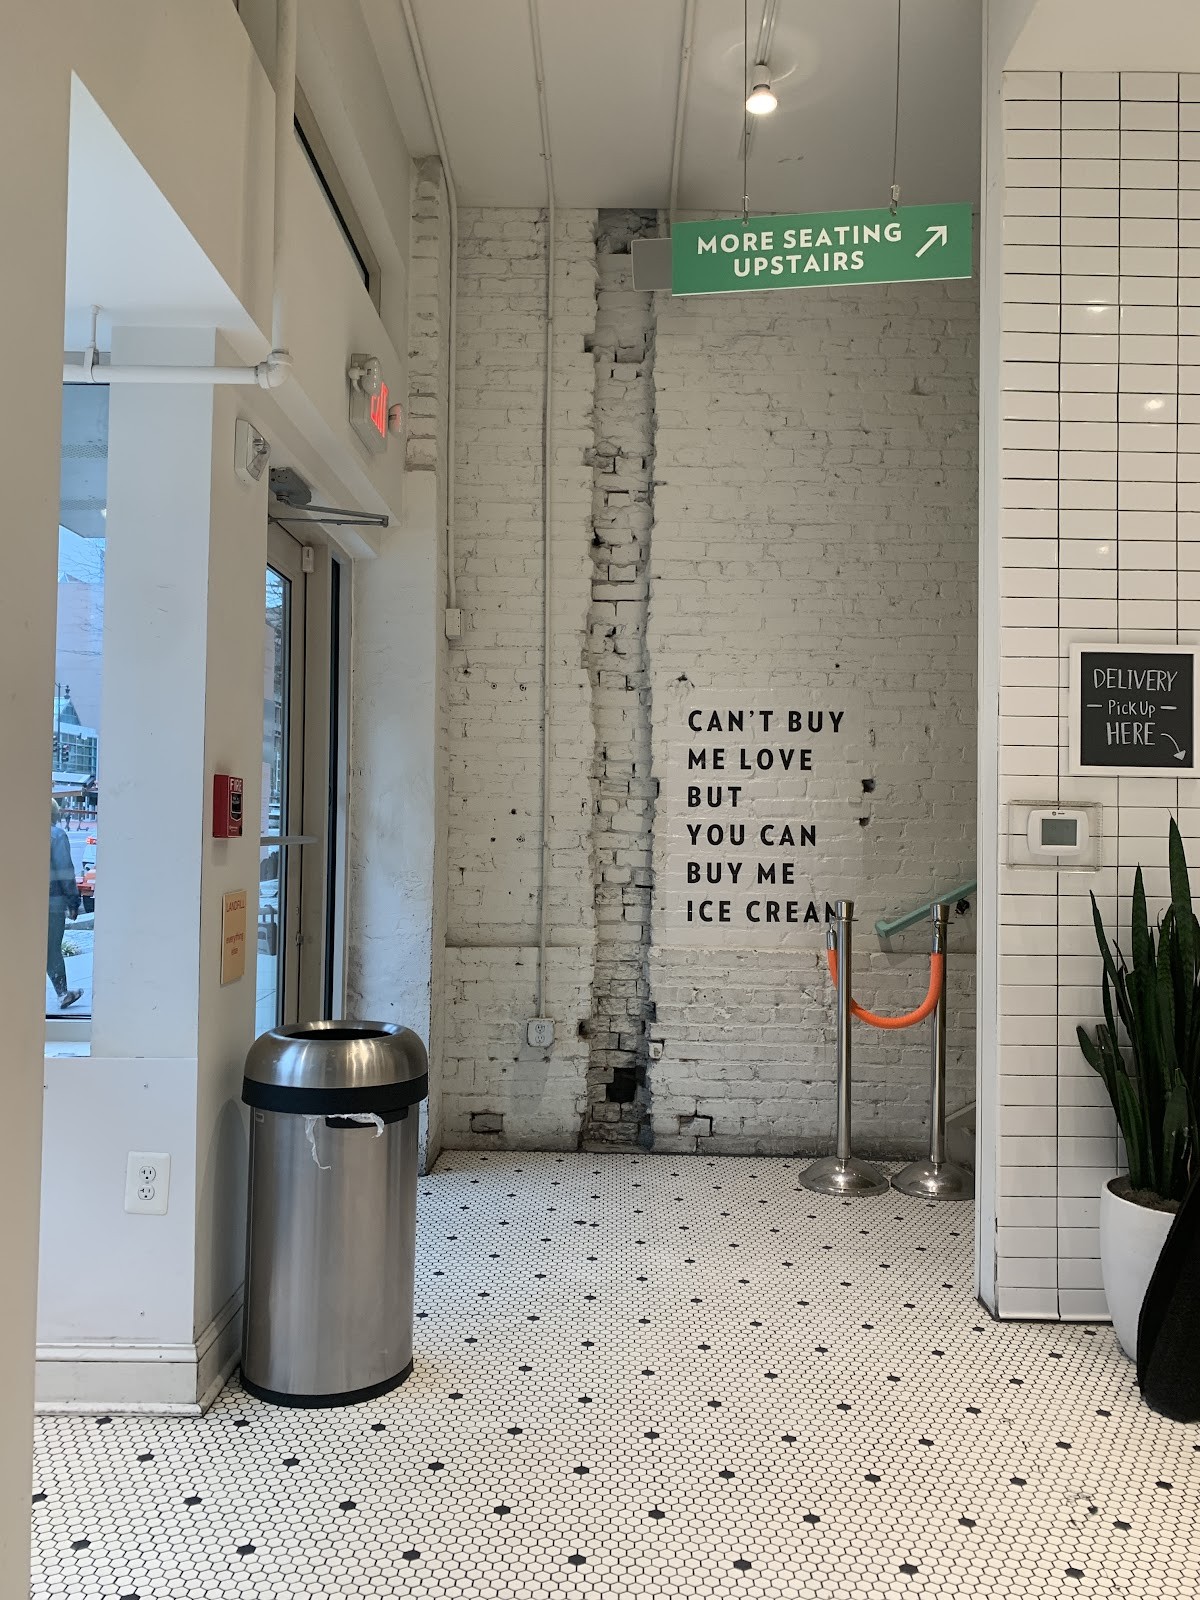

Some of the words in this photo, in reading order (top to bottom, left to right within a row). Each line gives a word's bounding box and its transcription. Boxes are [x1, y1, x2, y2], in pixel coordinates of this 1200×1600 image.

[697, 231, 774, 255] MORE
[783, 223, 902, 249] SEATING
[734, 250, 865, 278] UPSTAIRS
[1093, 668, 1178, 692] DELIVERY
[688, 709, 774, 732] CAN'T
[788, 710, 845, 733] BUY
[1106, 721, 1156, 746] HERE
[687, 748, 725, 770] ME
[740, 748, 812, 771] LOVE
[229, 778, 242, 792] FIRE
[687, 786, 742, 808] BUT
[686, 824, 745, 846] YOU
[760, 824, 816, 847] CAN
[687, 862, 743, 884] BUY
[757, 862, 795, 885] ME
[686, 900, 731, 922] ICE
